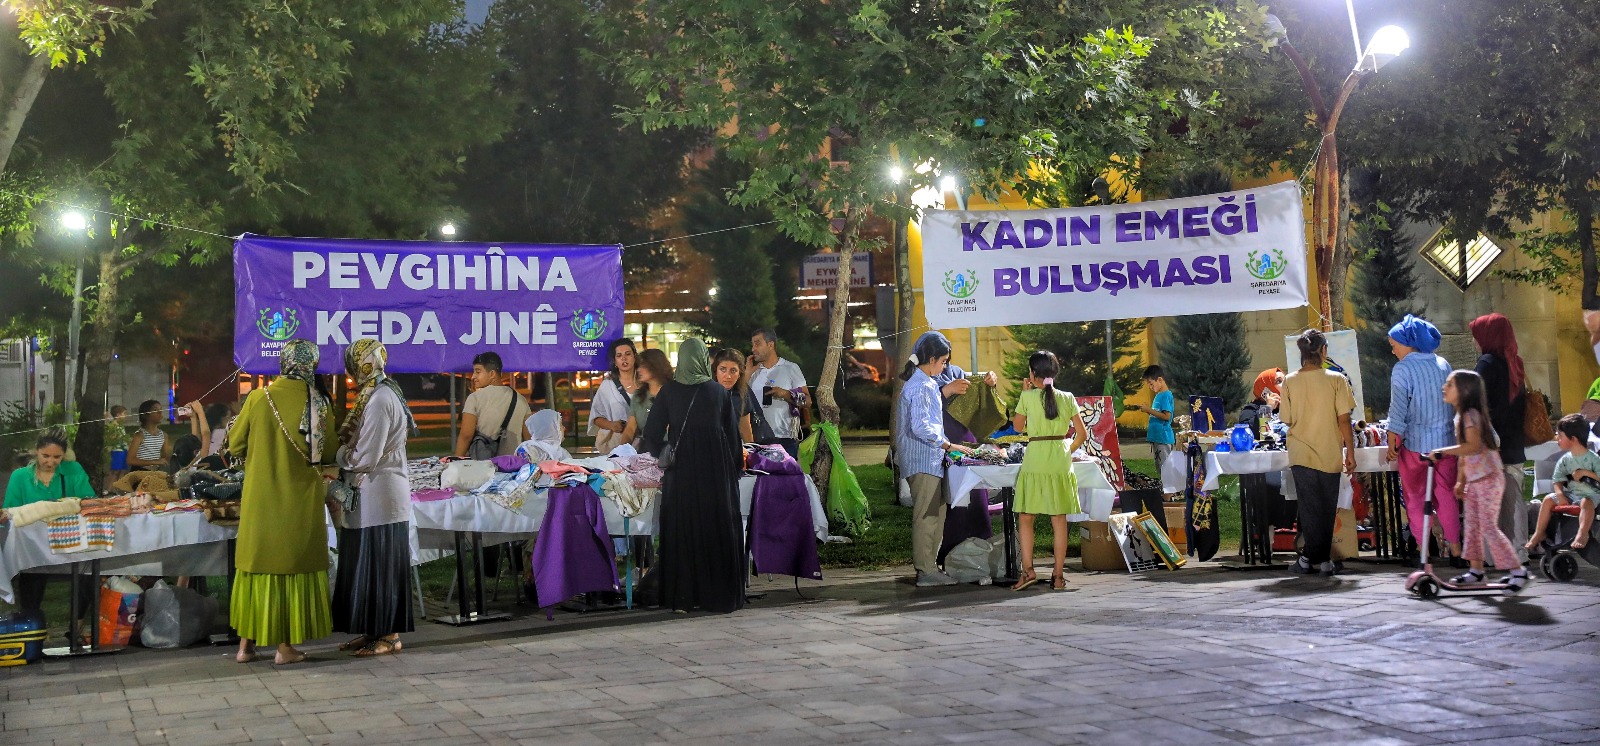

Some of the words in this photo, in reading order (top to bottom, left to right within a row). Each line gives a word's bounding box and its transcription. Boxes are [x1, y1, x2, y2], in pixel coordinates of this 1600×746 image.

[960, 214, 1101, 252] KADIN
[1115, 193, 1259, 243] EMEĞİ
[292, 246, 578, 292] PEVGIHÎNA
[993, 254, 1232, 297] BULUŞMASI
[316, 310, 448, 345] KEDA
[458, 303, 558, 346] JINÊ
